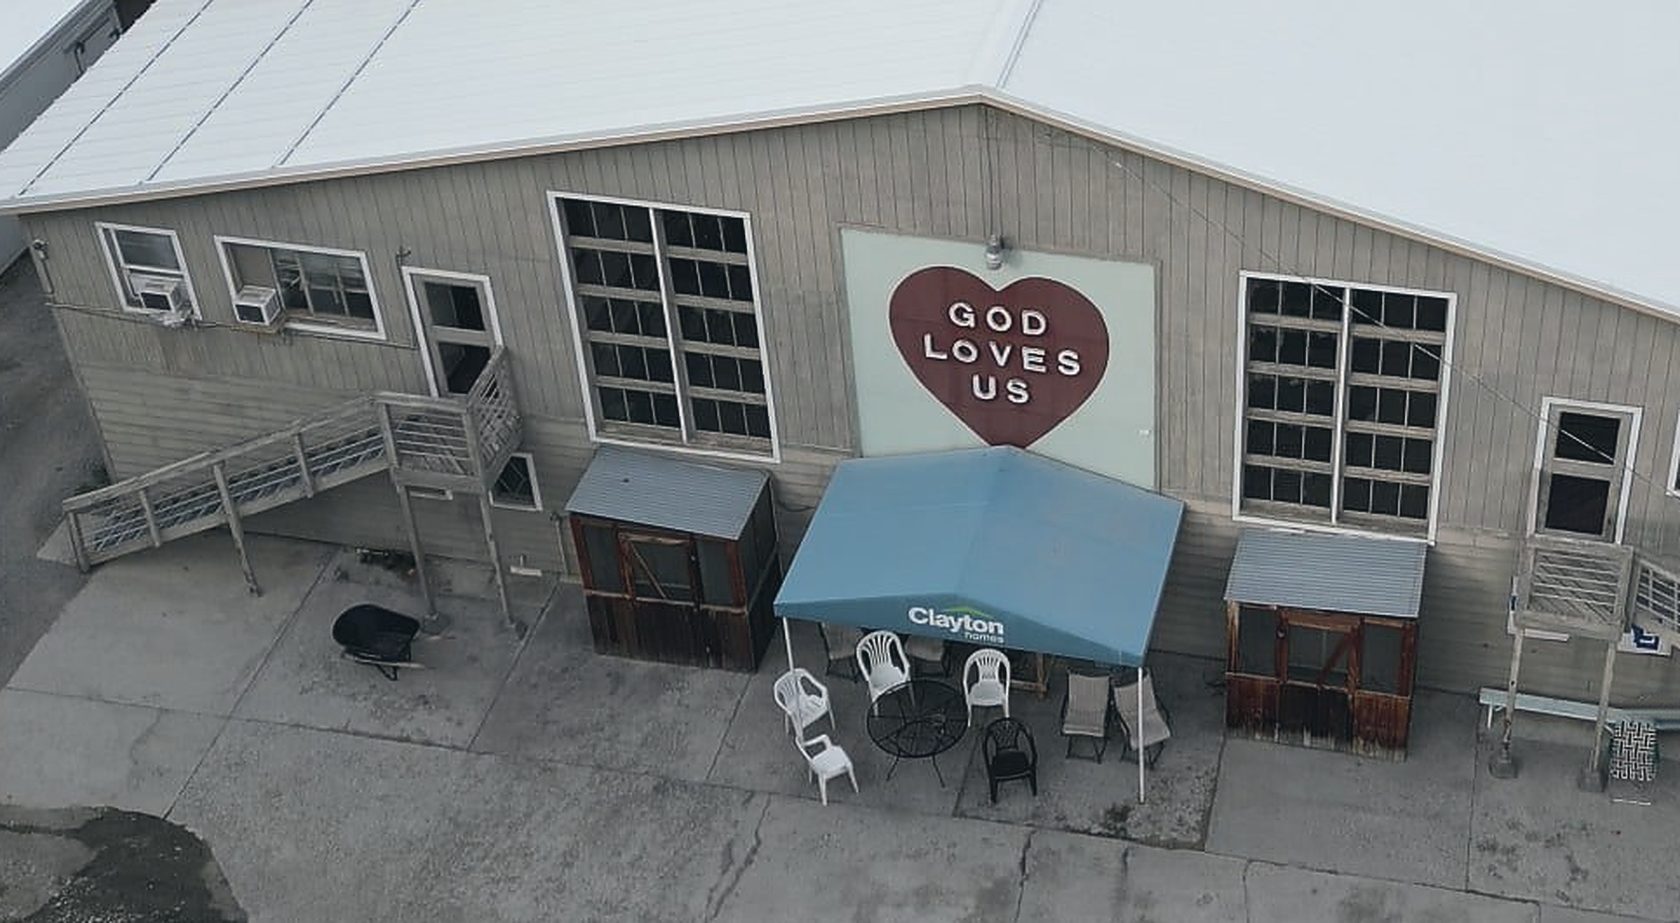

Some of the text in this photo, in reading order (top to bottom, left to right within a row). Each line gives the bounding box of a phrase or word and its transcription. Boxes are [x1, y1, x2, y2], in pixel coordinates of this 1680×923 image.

[949, 302, 1046, 336] GOD
[924, 333, 1081, 376] LOVES
[972, 374, 1030, 404] US
[908, 606, 1004, 635] Clayton
[965, 631, 1004, 644] homes
